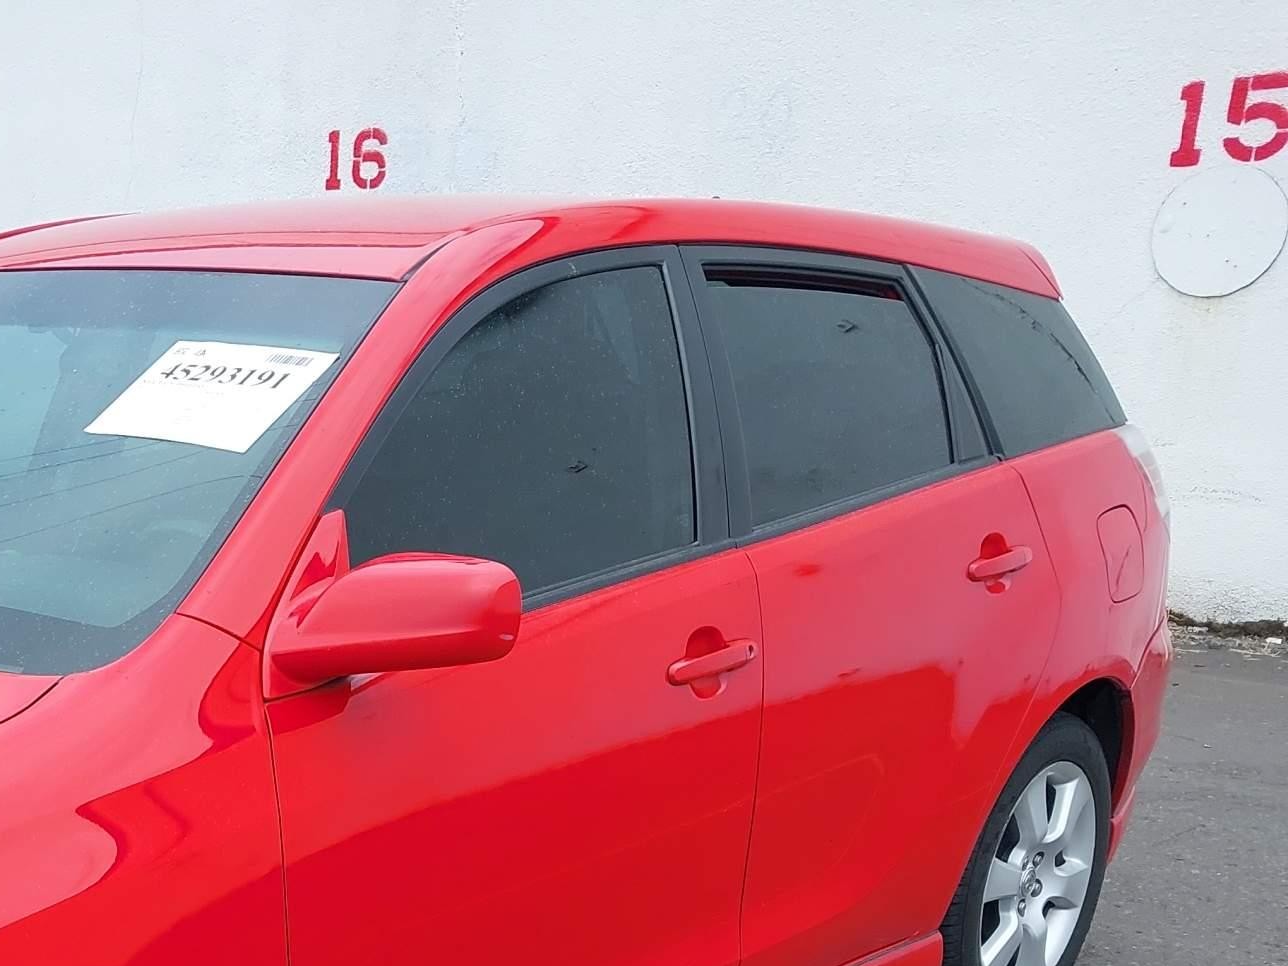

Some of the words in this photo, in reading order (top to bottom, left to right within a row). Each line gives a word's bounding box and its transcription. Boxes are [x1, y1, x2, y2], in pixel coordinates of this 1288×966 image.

[1169, 71, 1288, 168] 15
[324, 127, 388, 192] 16
[160, 362, 291, 389] 45293191
